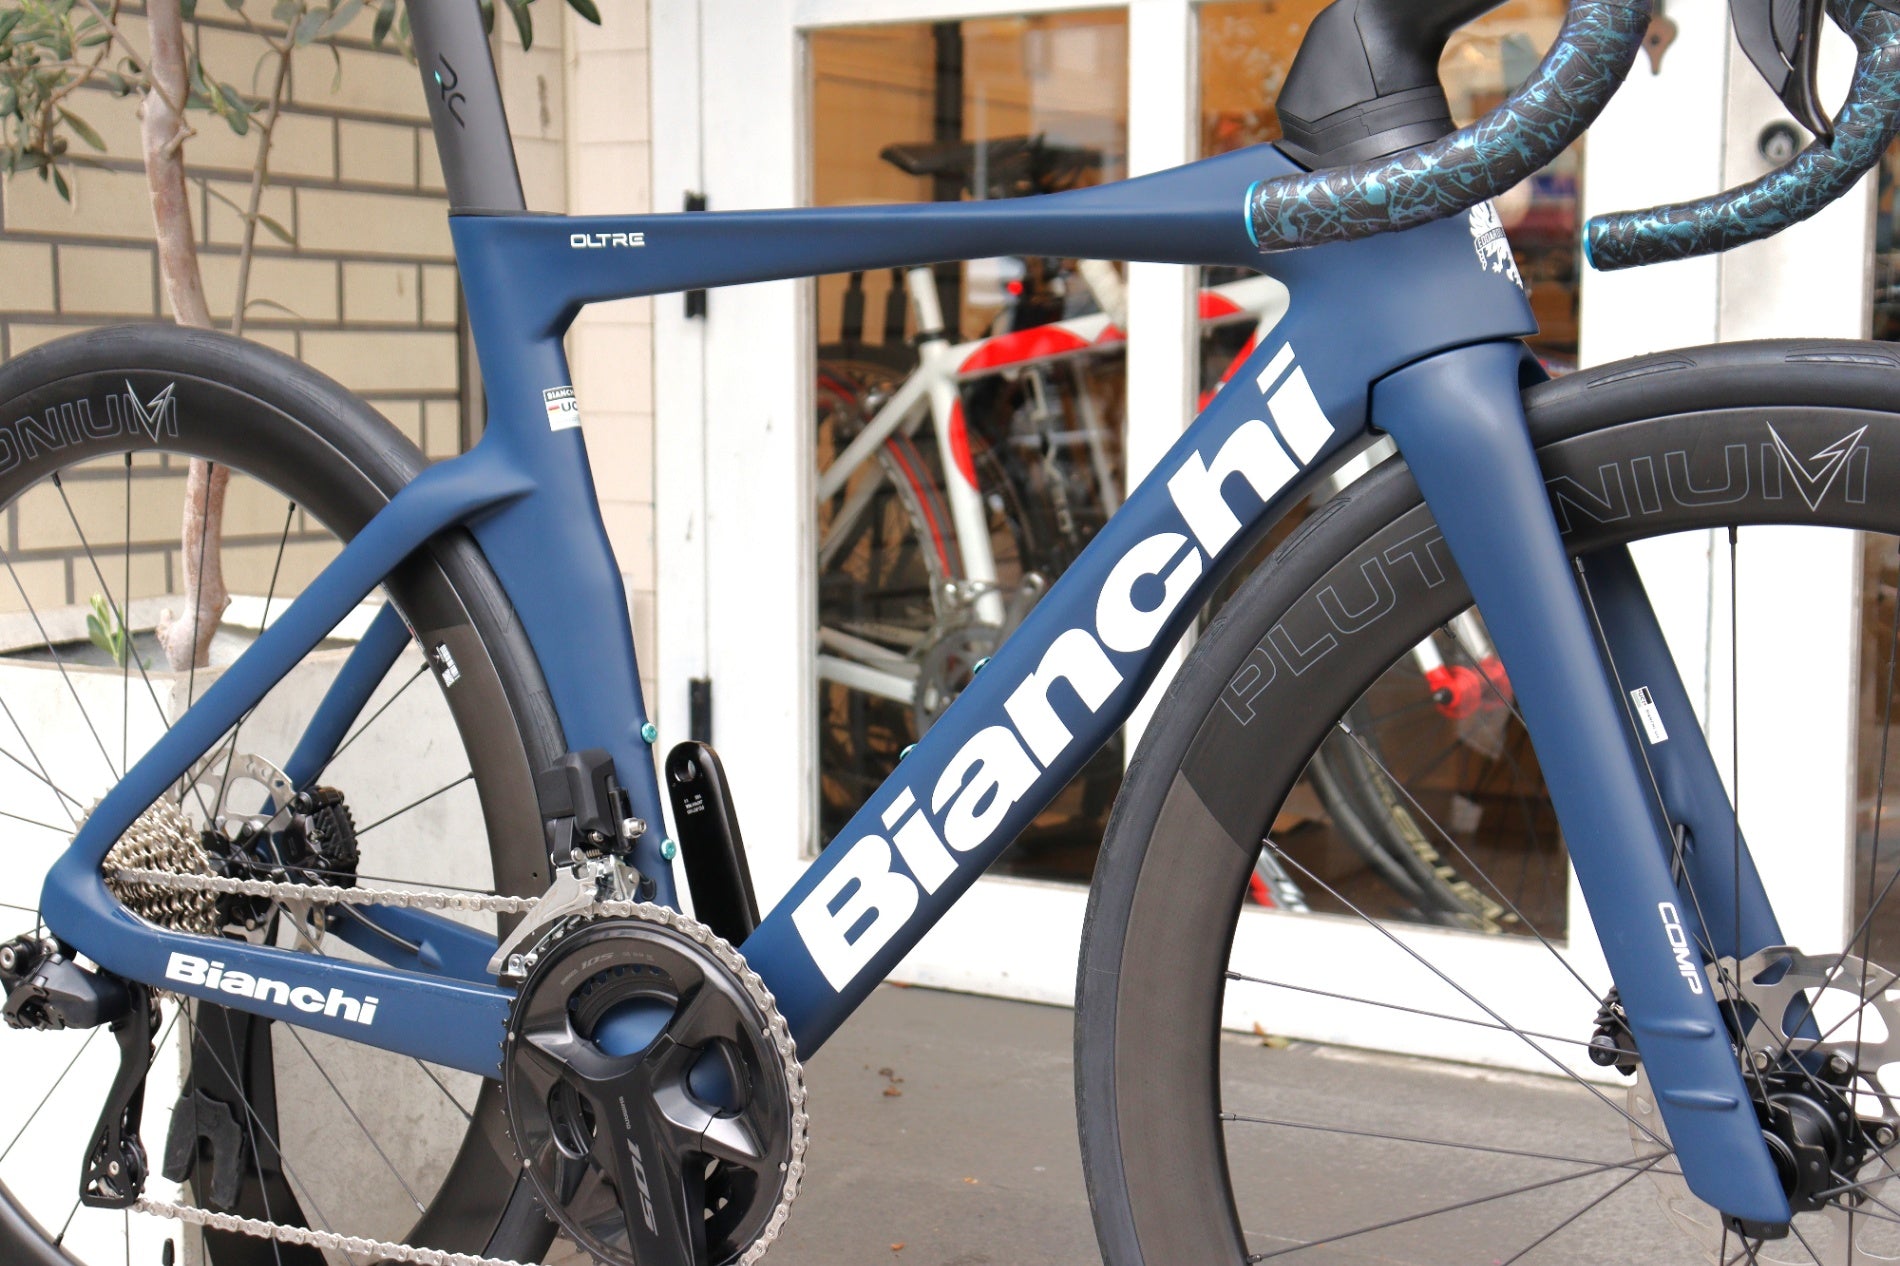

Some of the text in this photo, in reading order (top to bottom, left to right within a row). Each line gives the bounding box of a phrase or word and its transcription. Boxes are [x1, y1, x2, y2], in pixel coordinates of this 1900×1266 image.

[570, 232, 646, 248] OLTRE
[546, 389, 575, 400] BIANC
[1220, 421, 1869, 726] PLUTNIUM
[790, 340, 1336, 994] Bianchi
[165, 951, 379, 1025] Bianchi
[1658, 902, 1704, 994] COMP
[626, 1137, 659, 1236] 105
